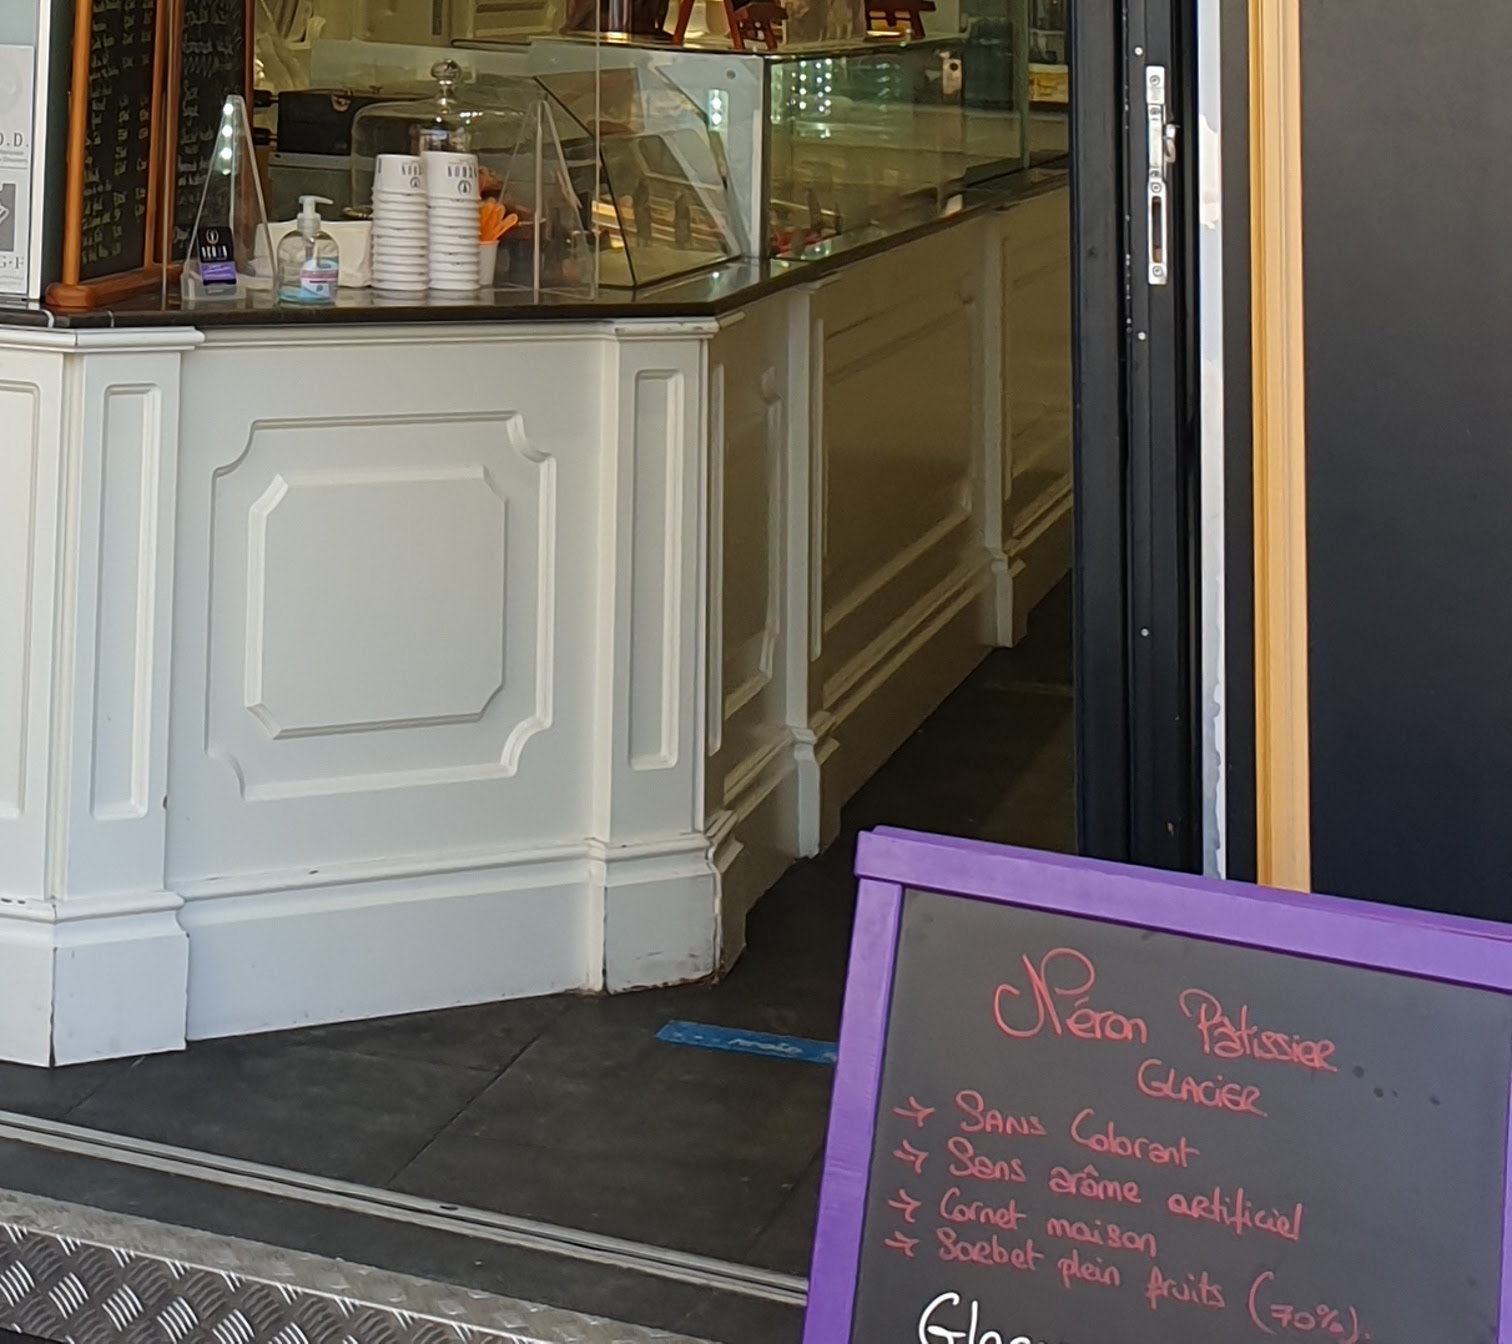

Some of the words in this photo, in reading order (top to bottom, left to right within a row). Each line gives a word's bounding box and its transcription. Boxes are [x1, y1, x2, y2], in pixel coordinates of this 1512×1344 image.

[993, 947, 1148, 1045] Néron
[1070, 1108, 1200, 1167] Colorant
[940, 1187, 1027, 1230] Cornet
[1047, 1216, 1156, 1257] maison
[947, 1136, 1026, 1183] Sans
[1048, 1164, 1142, 1203] arôme
[1168, 1186, 1303, 1241] artificiel
[1058, 1249, 1120, 1288] plein
[1145, 1266, 1225, 1310] fruits
